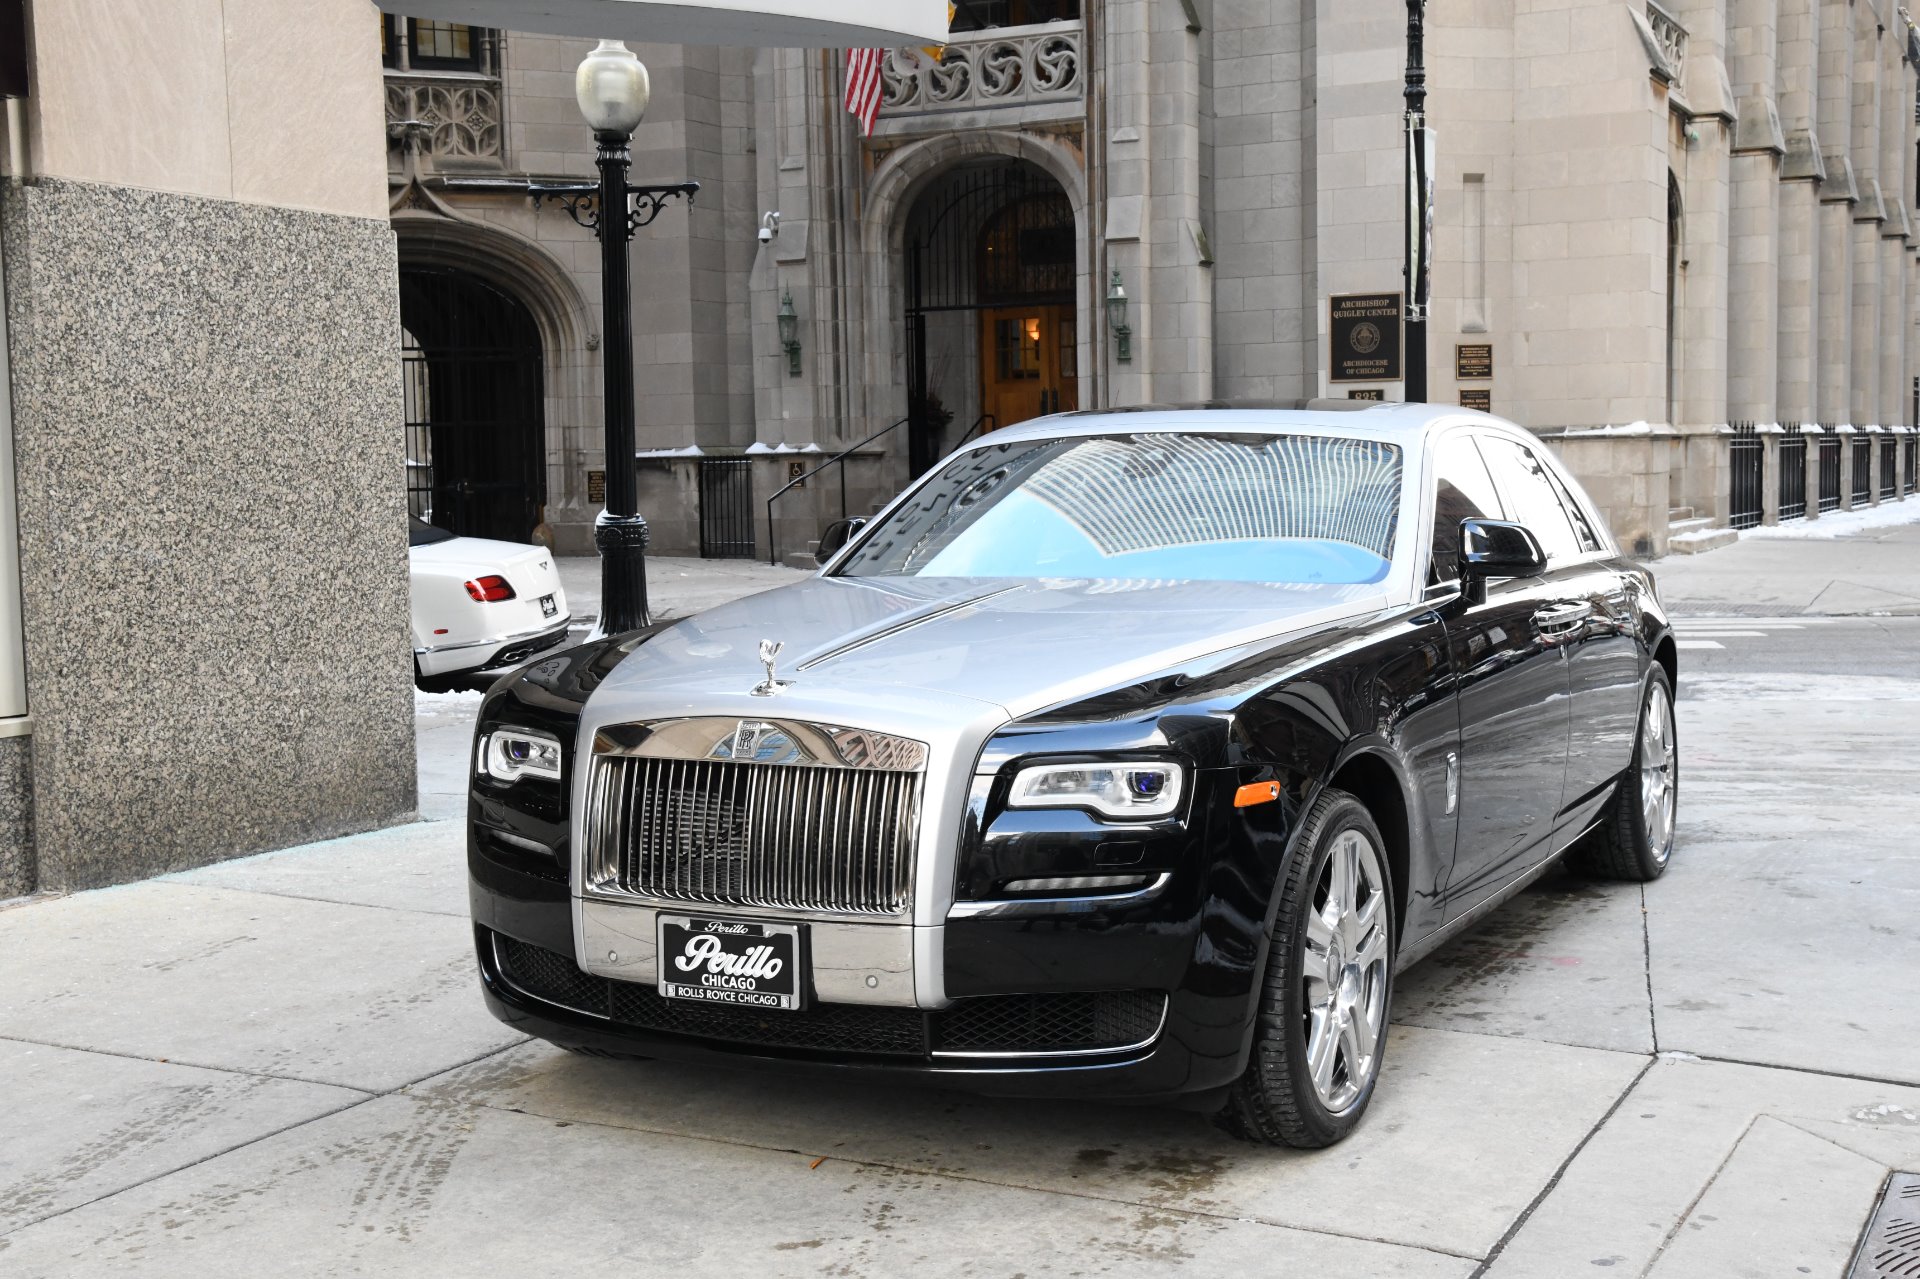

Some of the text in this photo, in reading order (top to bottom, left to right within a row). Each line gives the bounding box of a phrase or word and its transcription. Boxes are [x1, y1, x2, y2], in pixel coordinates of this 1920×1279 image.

[1340, 299, 1390, 308] ARCHBISHOP
[1333, 308, 1397, 318] QUIGLEY CENTER
[1342, 359, 1389, 367] ARCHDIOCESE
[1356, 367, 1385, 375] CHICAGO
[704, 921, 749, 934] Perillo
[674, 934, 783, 980] Perillo
[701, 973, 756, 990] CHICAGO
[678, 986, 704, 999] ROLLS
[706, 988, 736, 1002] ROYCE
[738, 992, 778, 1006] CHICAGO
